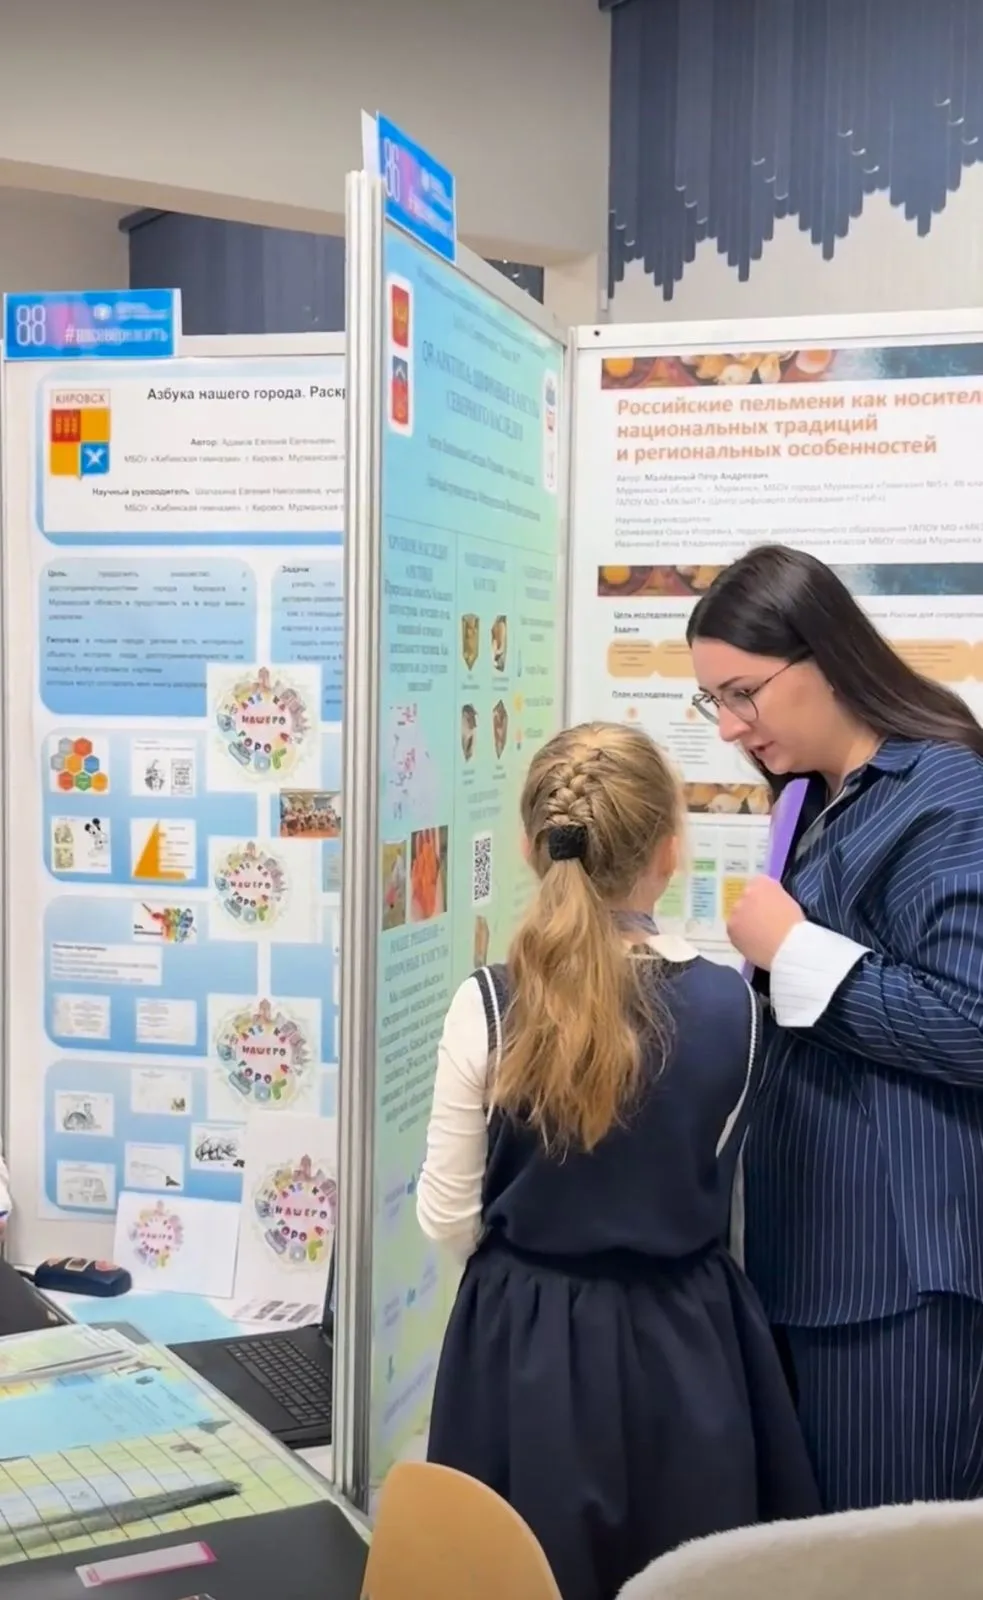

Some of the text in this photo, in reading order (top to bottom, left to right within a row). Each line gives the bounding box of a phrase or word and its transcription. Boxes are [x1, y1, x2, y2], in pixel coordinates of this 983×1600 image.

[16, 304, 46, 346] 88
[55, 393, 106, 405] КИРОВСК
[147, 387, 195, 402] Азбука
[198, 389, 250, 400] нашего
[253, 388, 305, 402] города.
[617, 396, 734, 416] Российские
[740, 394, 845, 413] пельмени
[851, 392, 887, 408] как
[617, 414, 878, 439] национальных традиций
[617, 435, 937, 465] и региональных особенностей
[241, 715, 286, 725] НАШЕГО
[242, 1045, 287, 1057] НАШЕГО
[275, 1205, 328, 1219] НАШЕГО
